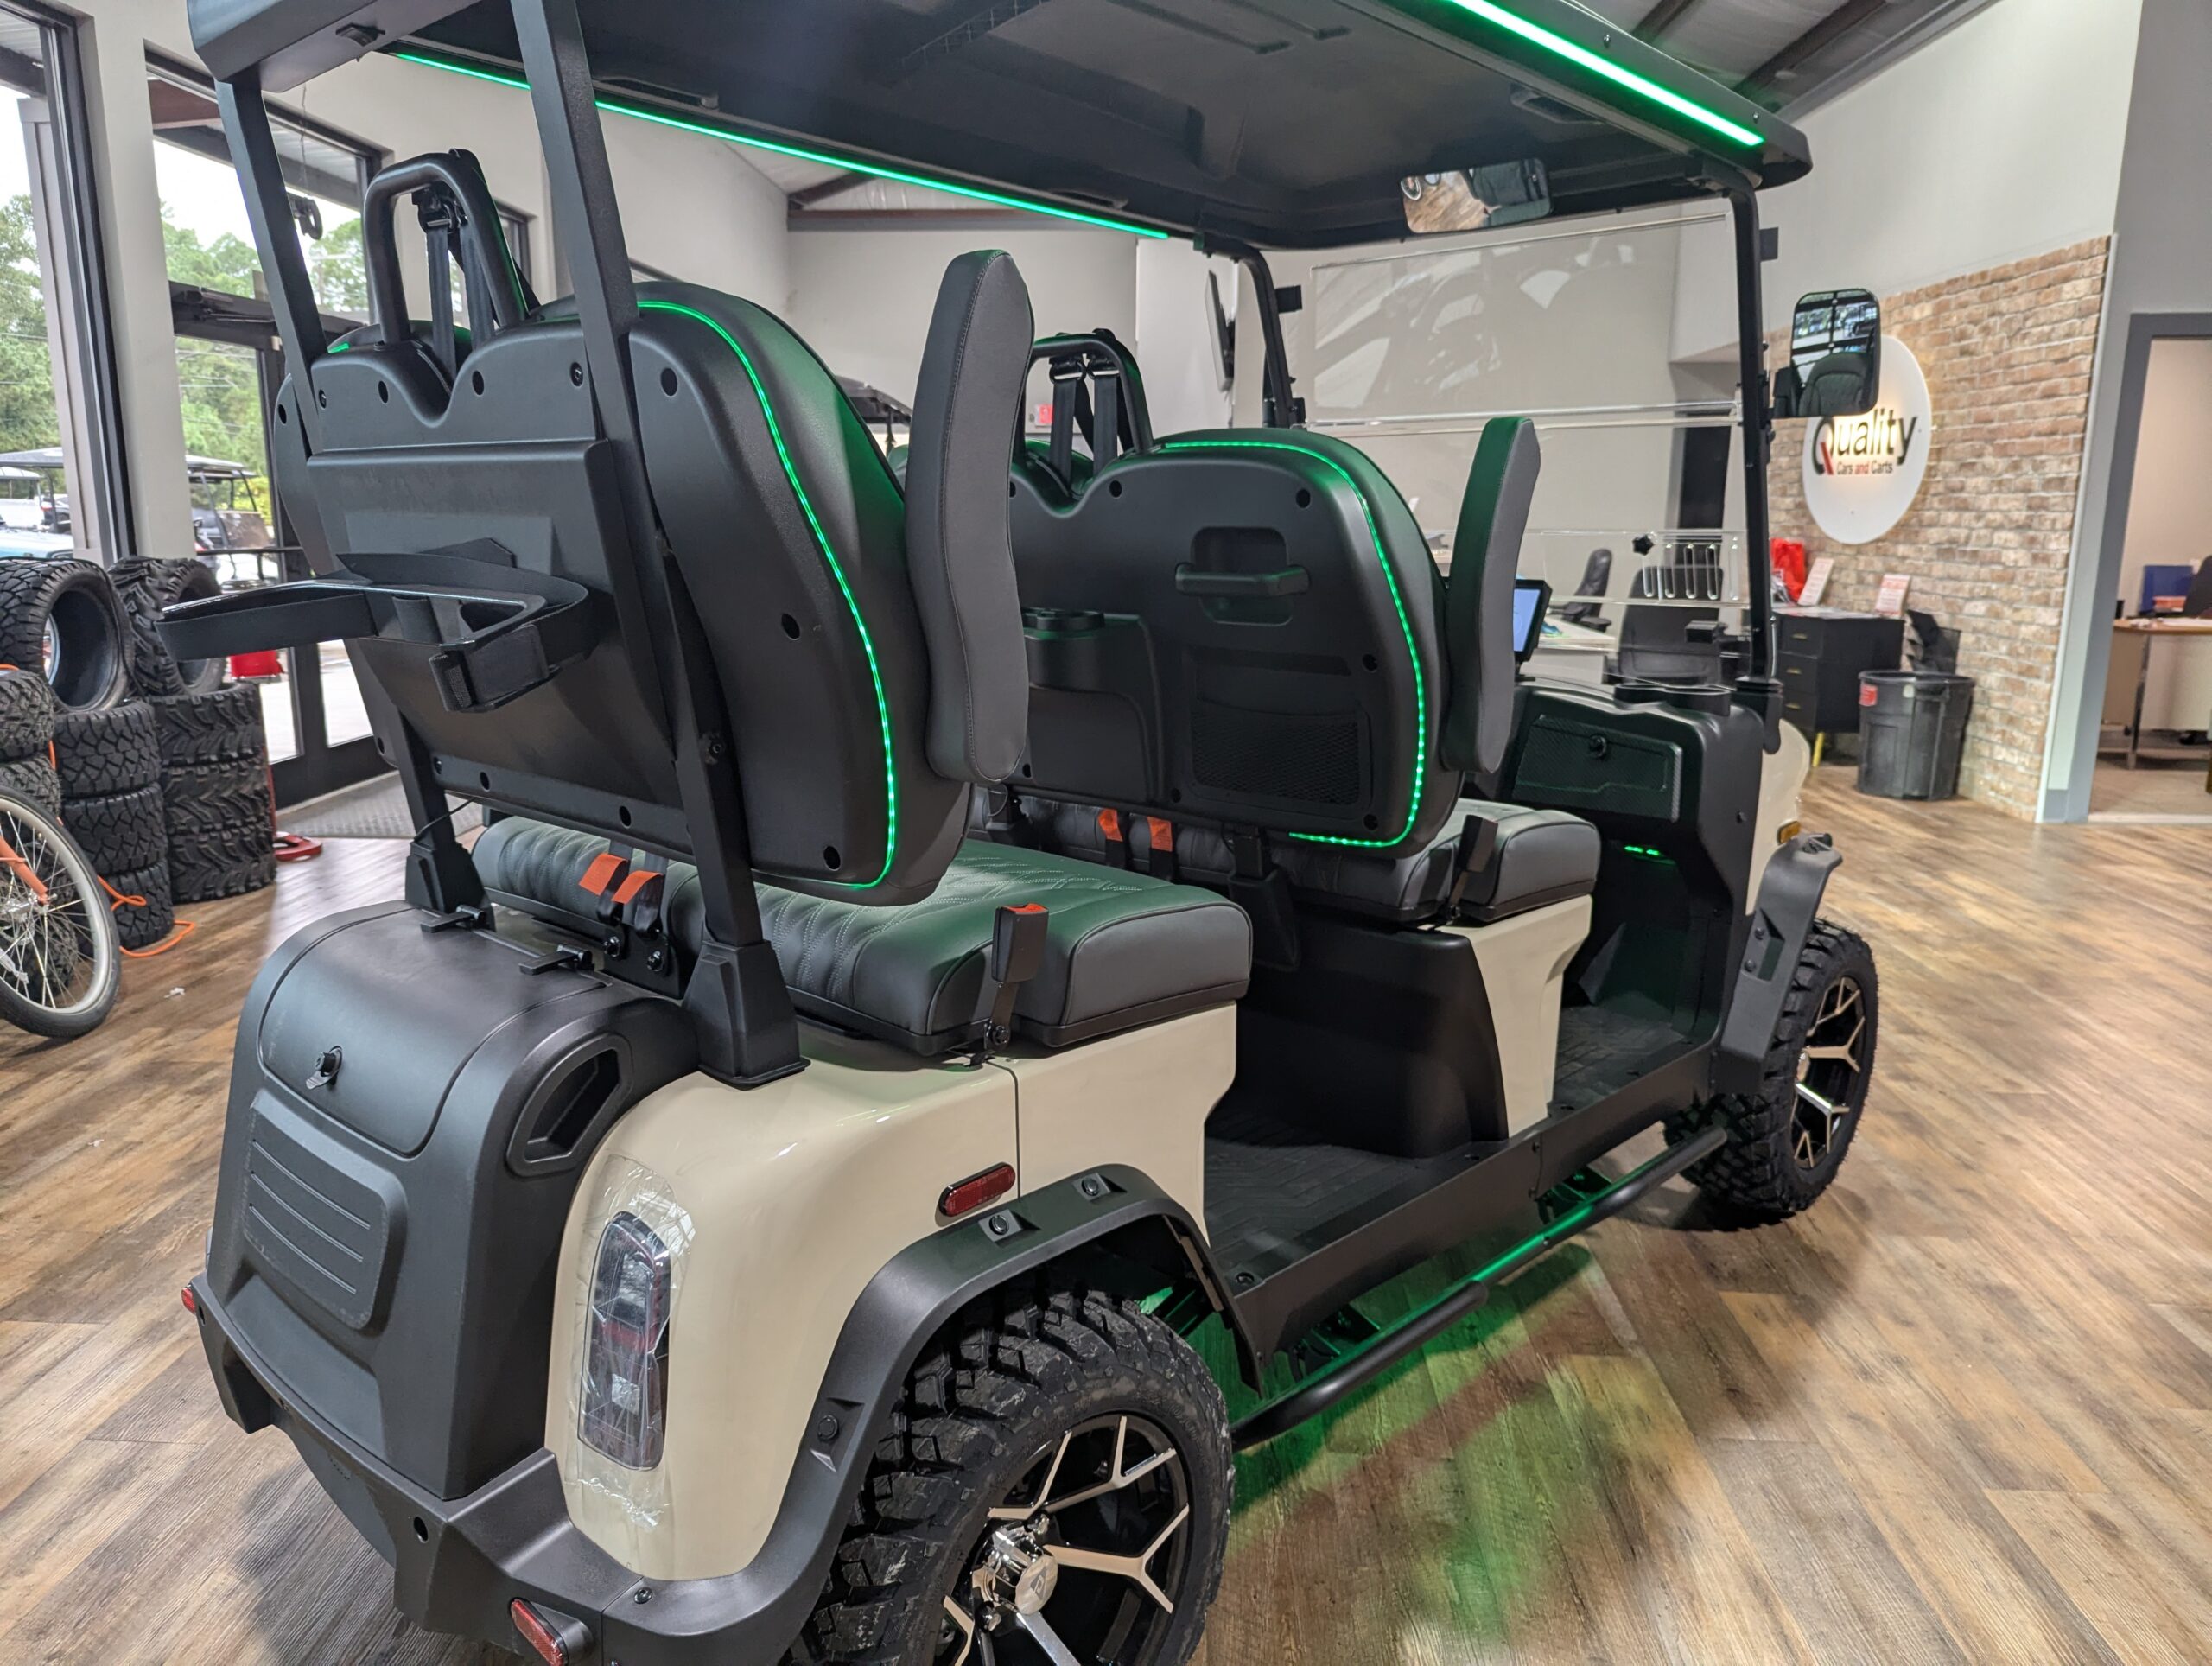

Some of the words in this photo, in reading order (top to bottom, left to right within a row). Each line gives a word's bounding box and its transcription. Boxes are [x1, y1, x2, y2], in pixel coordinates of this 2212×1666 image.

[1812, 408, 1917, 475] Quality
[1836, 461, 1853, 474] Cars
[1854, 462, 1870, 474] and
[1872, 460, 1893, 474] Carts
